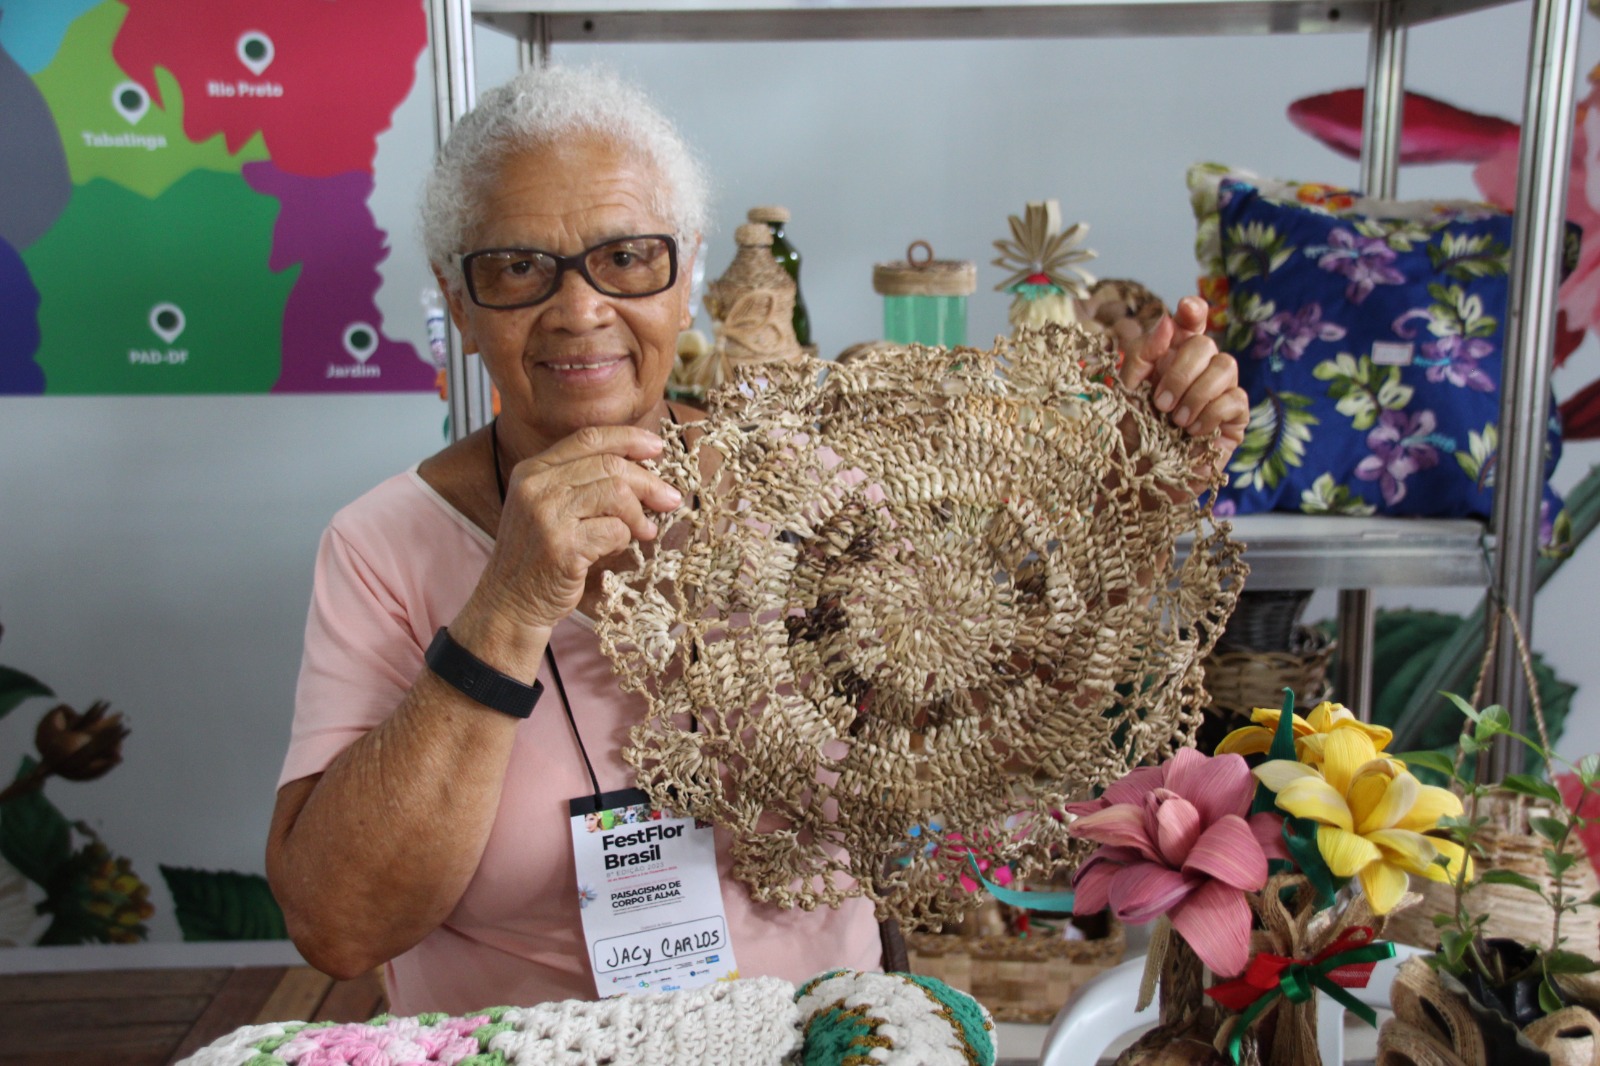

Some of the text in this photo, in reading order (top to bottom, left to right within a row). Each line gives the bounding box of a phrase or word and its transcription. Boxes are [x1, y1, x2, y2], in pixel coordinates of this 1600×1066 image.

[207, 82, 284, 97] Rio Preto
[82, 131, 167, 151] Tabatinga
[129, 350, 189, 364] PAD-DF
[326, 363, 381, 378] Jardim
[602, 825, 685, 851] FestFlor
[604, 844, 661, 870] Brasil
[611, 883, 667, 900] PAISAGISMO
[668, 880, 682, 889] DE
[612, 896, 645, 908] CORPO
[646, 894, 653, 902] E
[654, 889, 681, 900] ALMA
[661, 930, 720, 958] CARLOS
